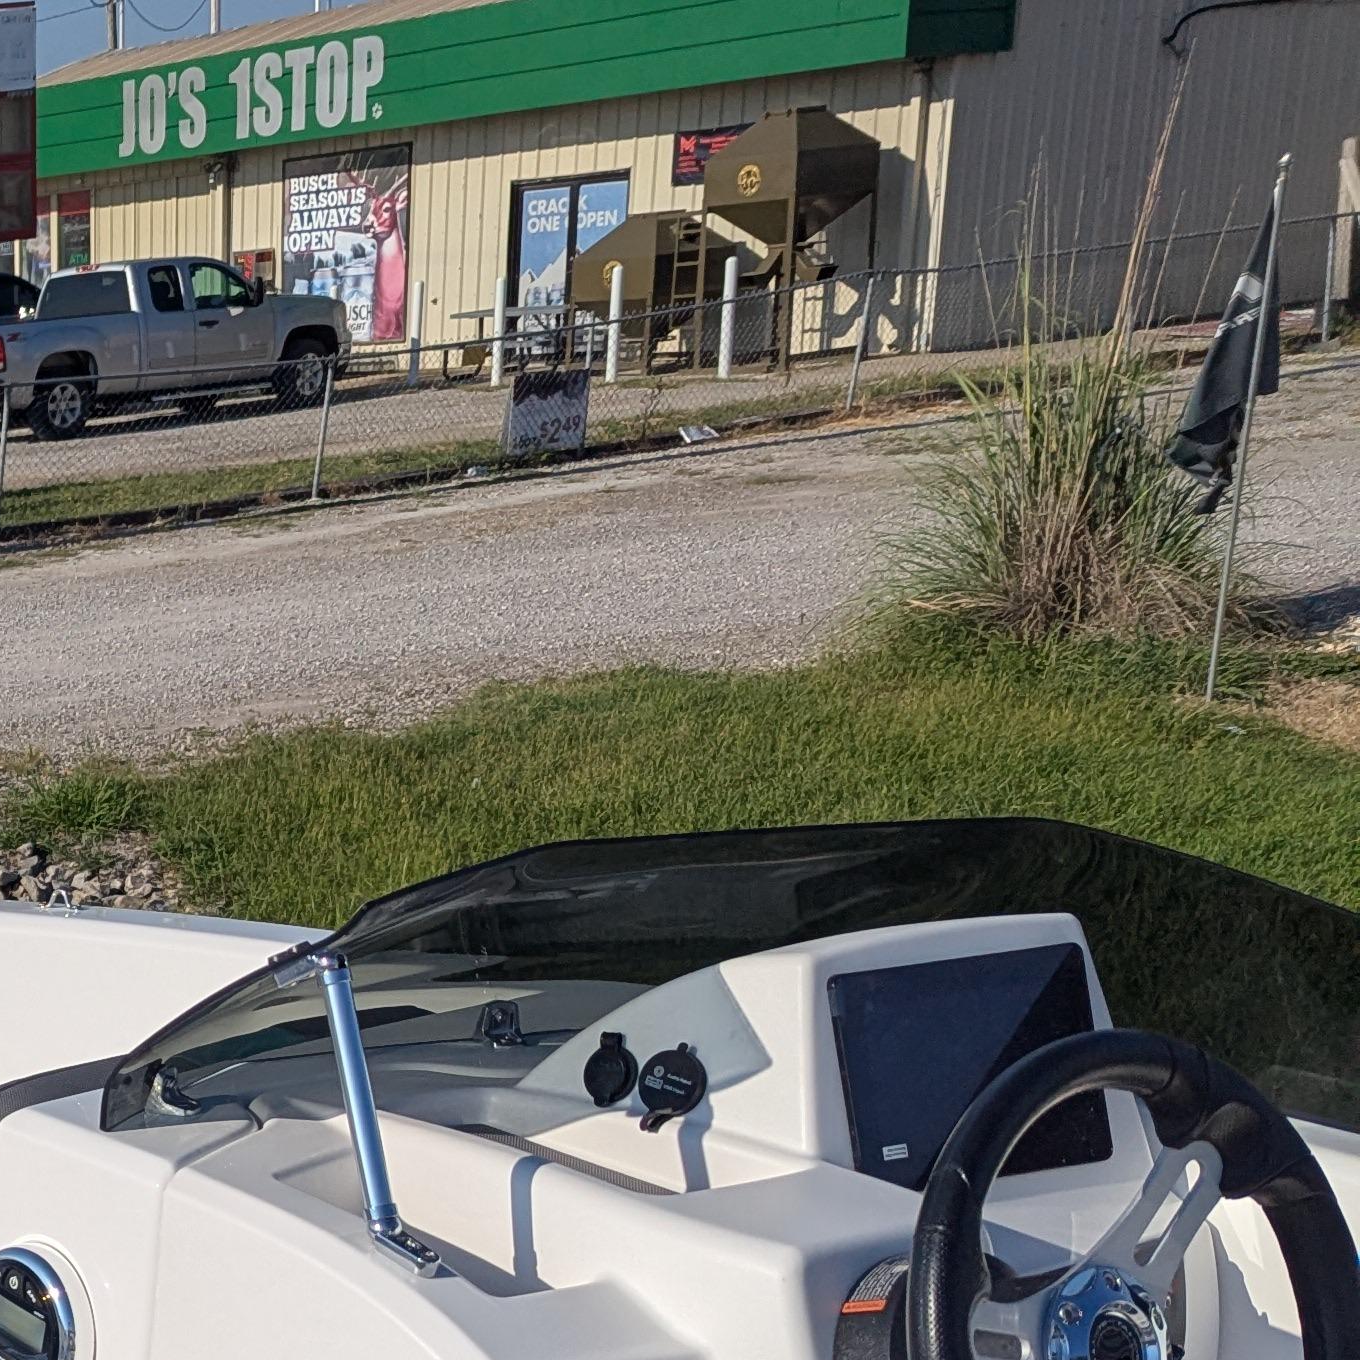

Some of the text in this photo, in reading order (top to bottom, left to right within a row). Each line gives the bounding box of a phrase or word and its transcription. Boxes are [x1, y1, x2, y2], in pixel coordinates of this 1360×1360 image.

[119, 67, 206, 157] JO'S
[290, 173, 338, 194] BUSCH
[290, 186, 366, 212] SEASON IS
[528, 194, 588, 217] CRACK
[289, 206, 362, 232] ALWAYS
[527, 209, 618, 233] ONE OPEN
[289, 229, 335, 252] OPEN
[347, 303, 373, 321] USCH
